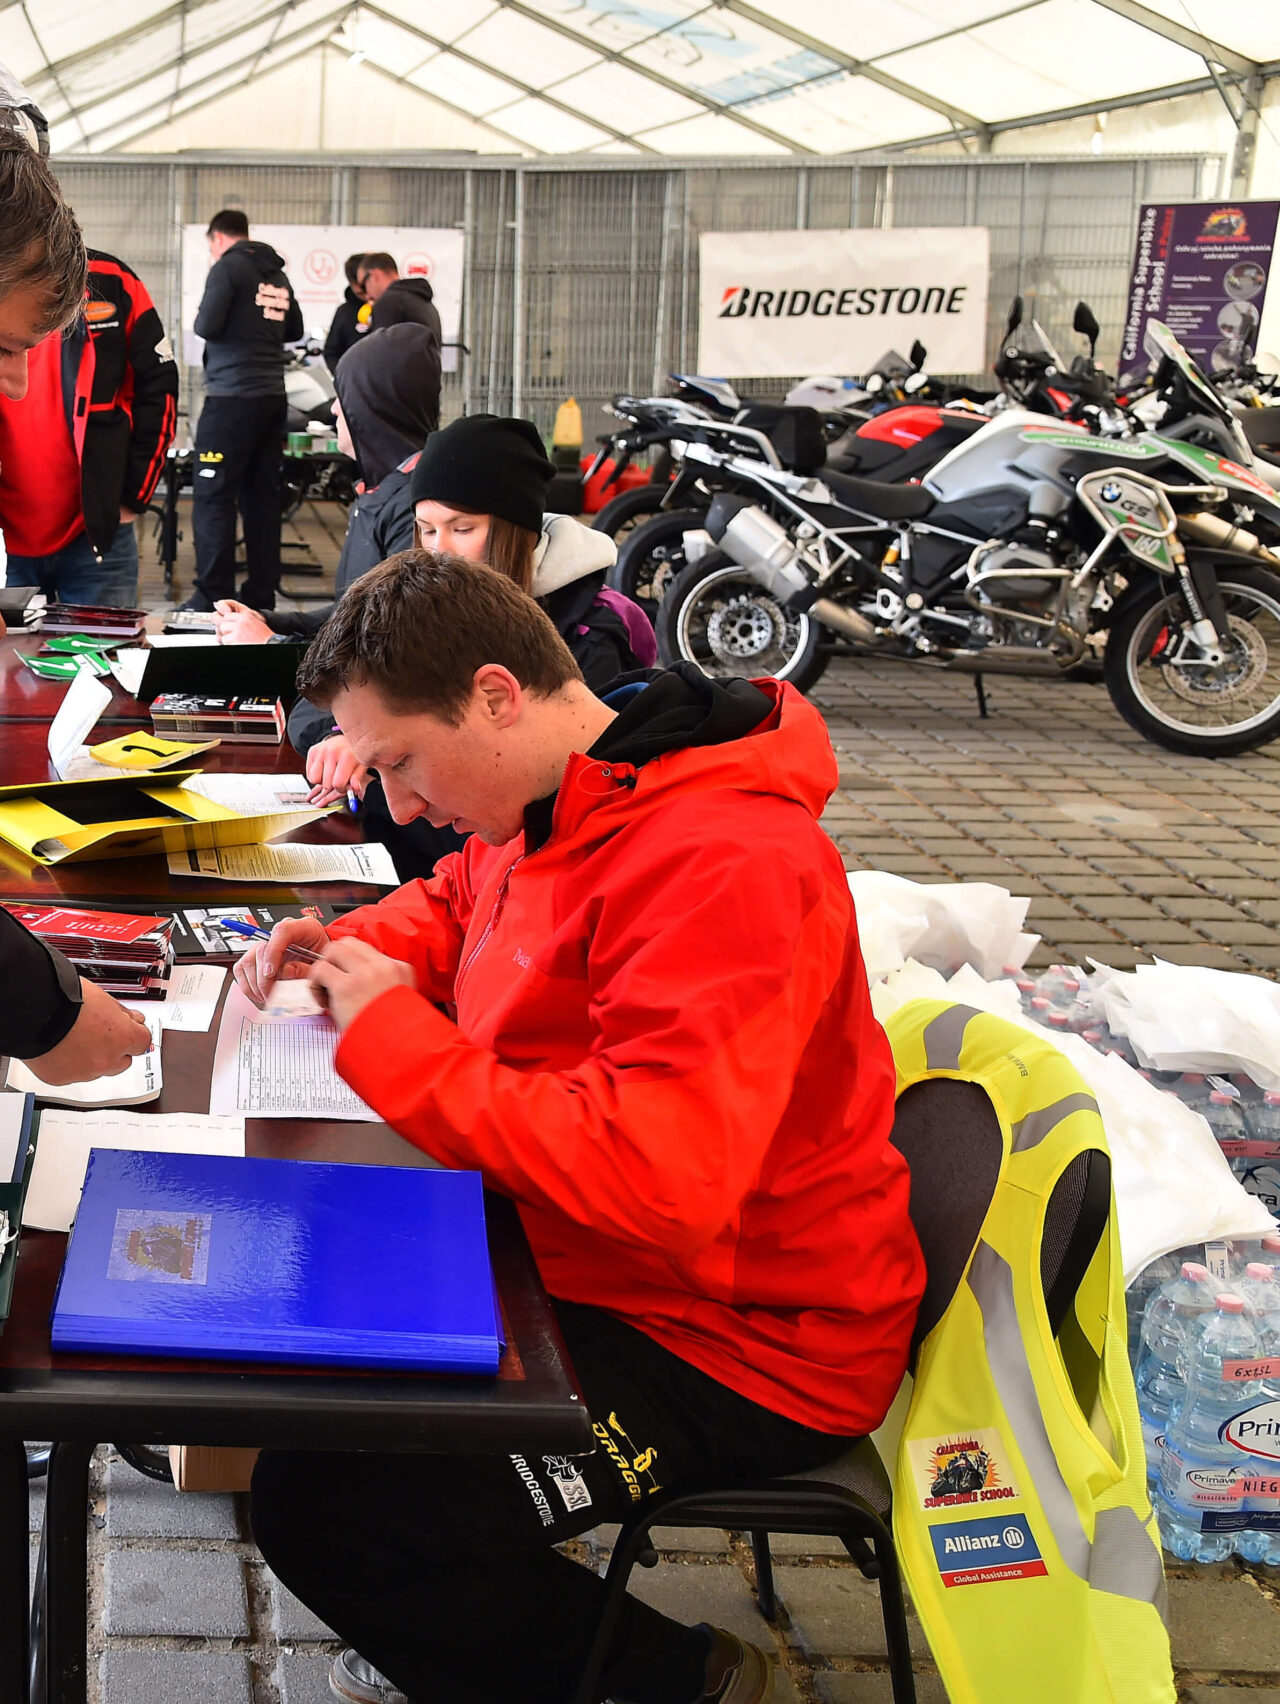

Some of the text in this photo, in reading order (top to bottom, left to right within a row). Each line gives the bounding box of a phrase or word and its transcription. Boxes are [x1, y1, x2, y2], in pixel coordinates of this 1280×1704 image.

[1122, 207, 1158, 361] California Superbike
[1145, 260, 1166, 312] School
[718, 286, 967, 318] BRIDGESTONE
[1120, 500, 1152, 518] GS
[936, 1440, 980, 1456] CALIFORNIA
[1242, 1480, 1278, 1493] NIEG
[924, 1486, 1016, 1509] SUPERBIKE SCHOOL
[944, 1534, 1002, 1554] Allianz
[953, 1568, 1023, 1584] Global Assistance
